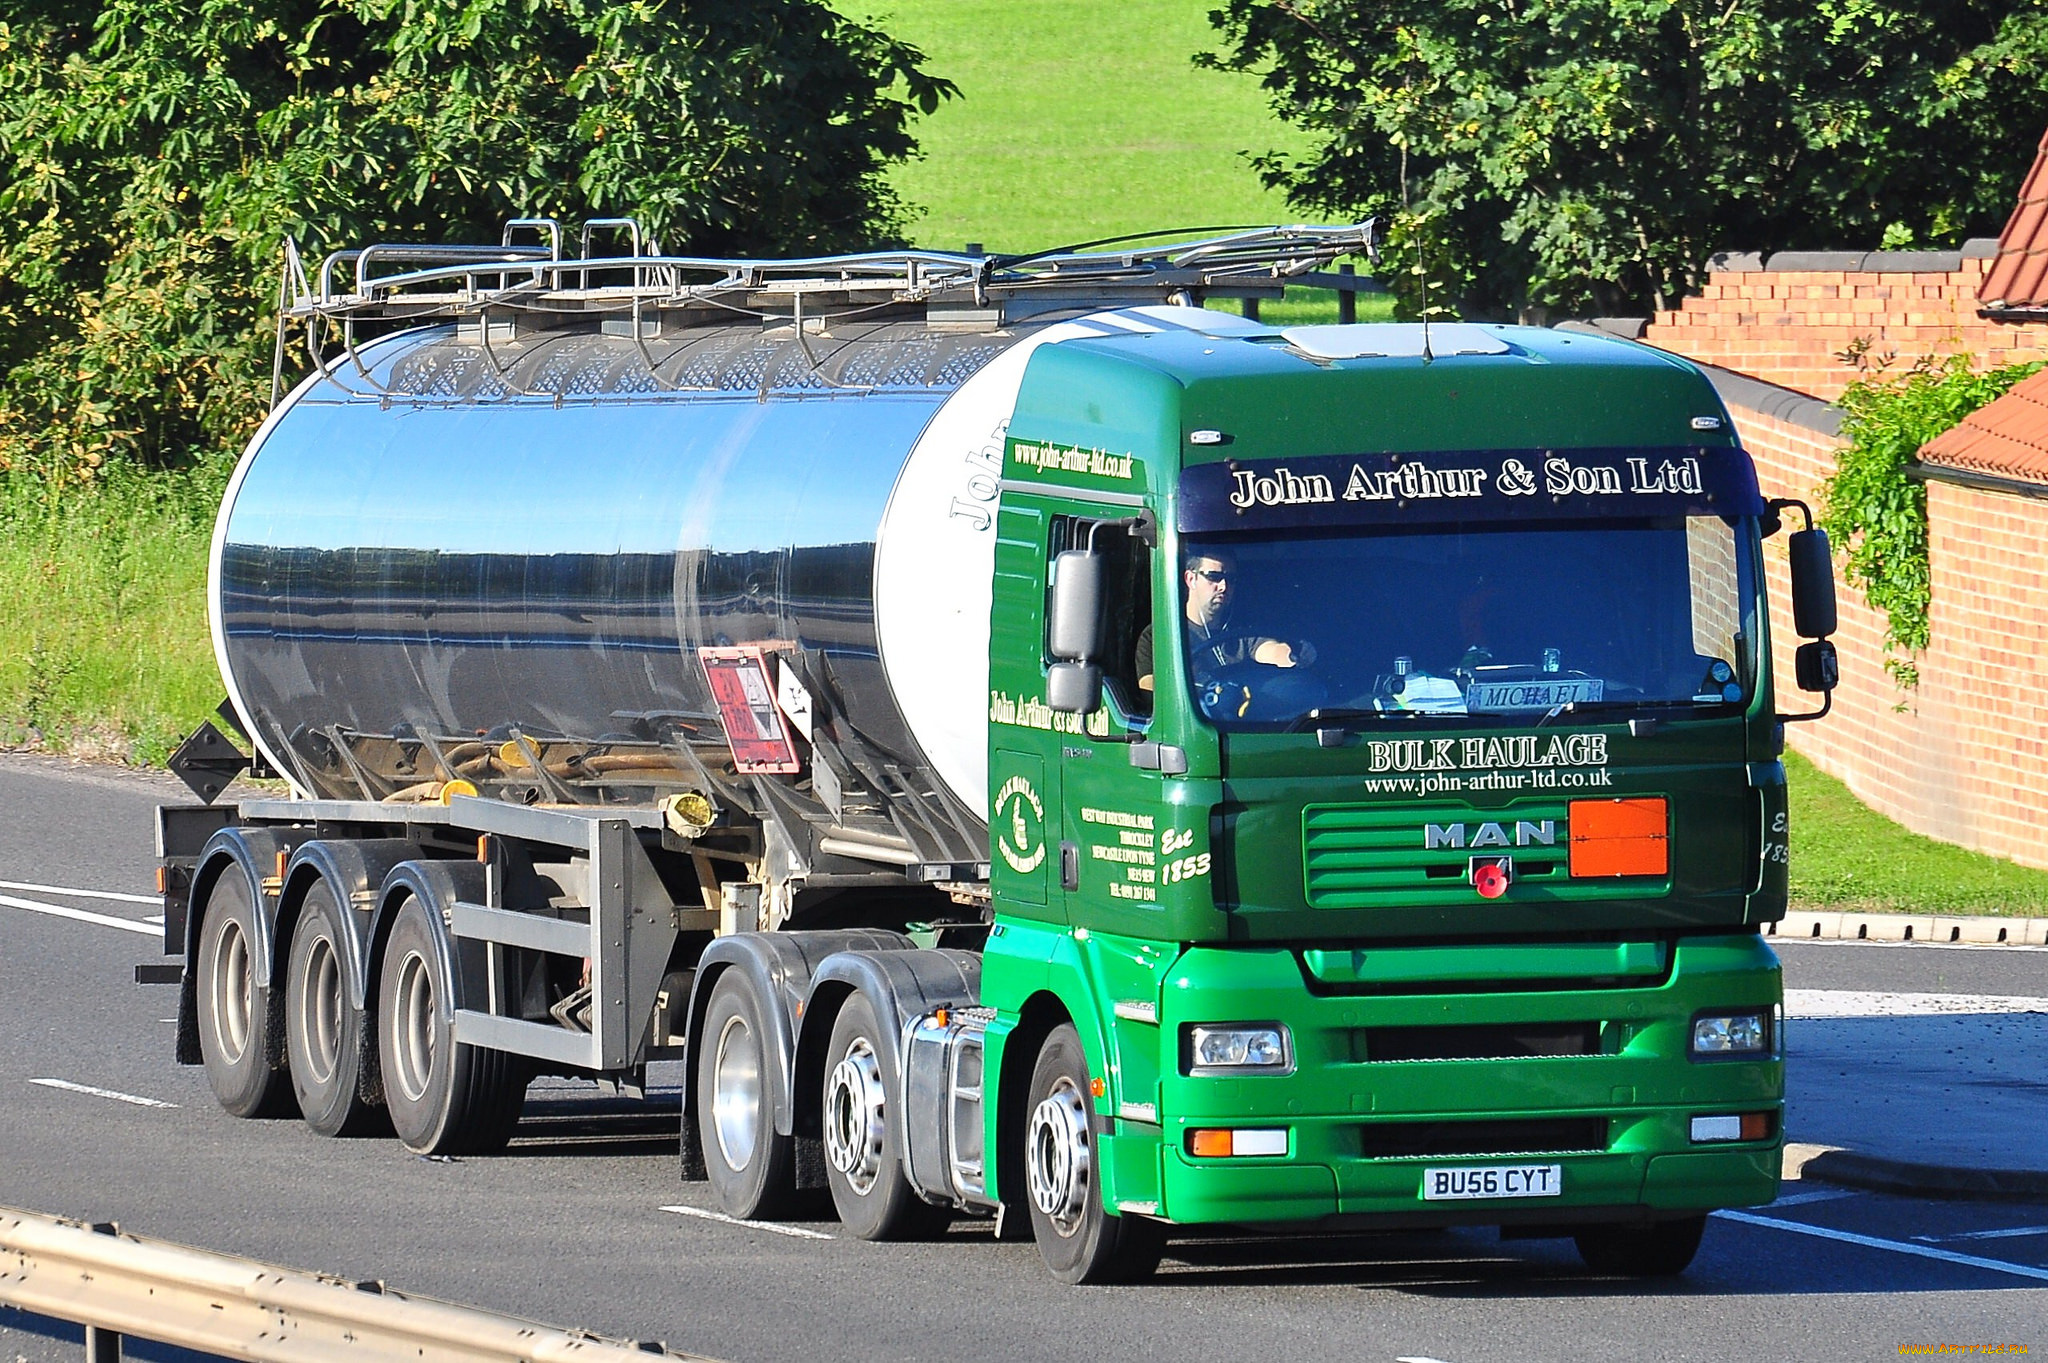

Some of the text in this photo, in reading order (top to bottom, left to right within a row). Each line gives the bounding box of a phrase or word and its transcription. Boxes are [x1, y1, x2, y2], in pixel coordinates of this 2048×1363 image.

[1014, 440, 1133, 479] www.john-arthur-ltd.co.uk
[1230, 458, 1703, 508] John Arthur & Son Ltd
[990, 690, 1015, 724] John
[1016, 694, 1053, 730] Arthur
[1485, 684, 1582, 707] MICHAEL
[1367, 733, 1608, 772] BULK HAULAGE
[1364, 767, 1612, 797] www.john-arthur-ltd.co.uk
[1160, 828, 1194, 855] Est
[1424, 820, 1555, 849] MAN
[1161, 853, 1211, 886] 1853
[1435, 1168, 1552, 1195] BU56 CYT
